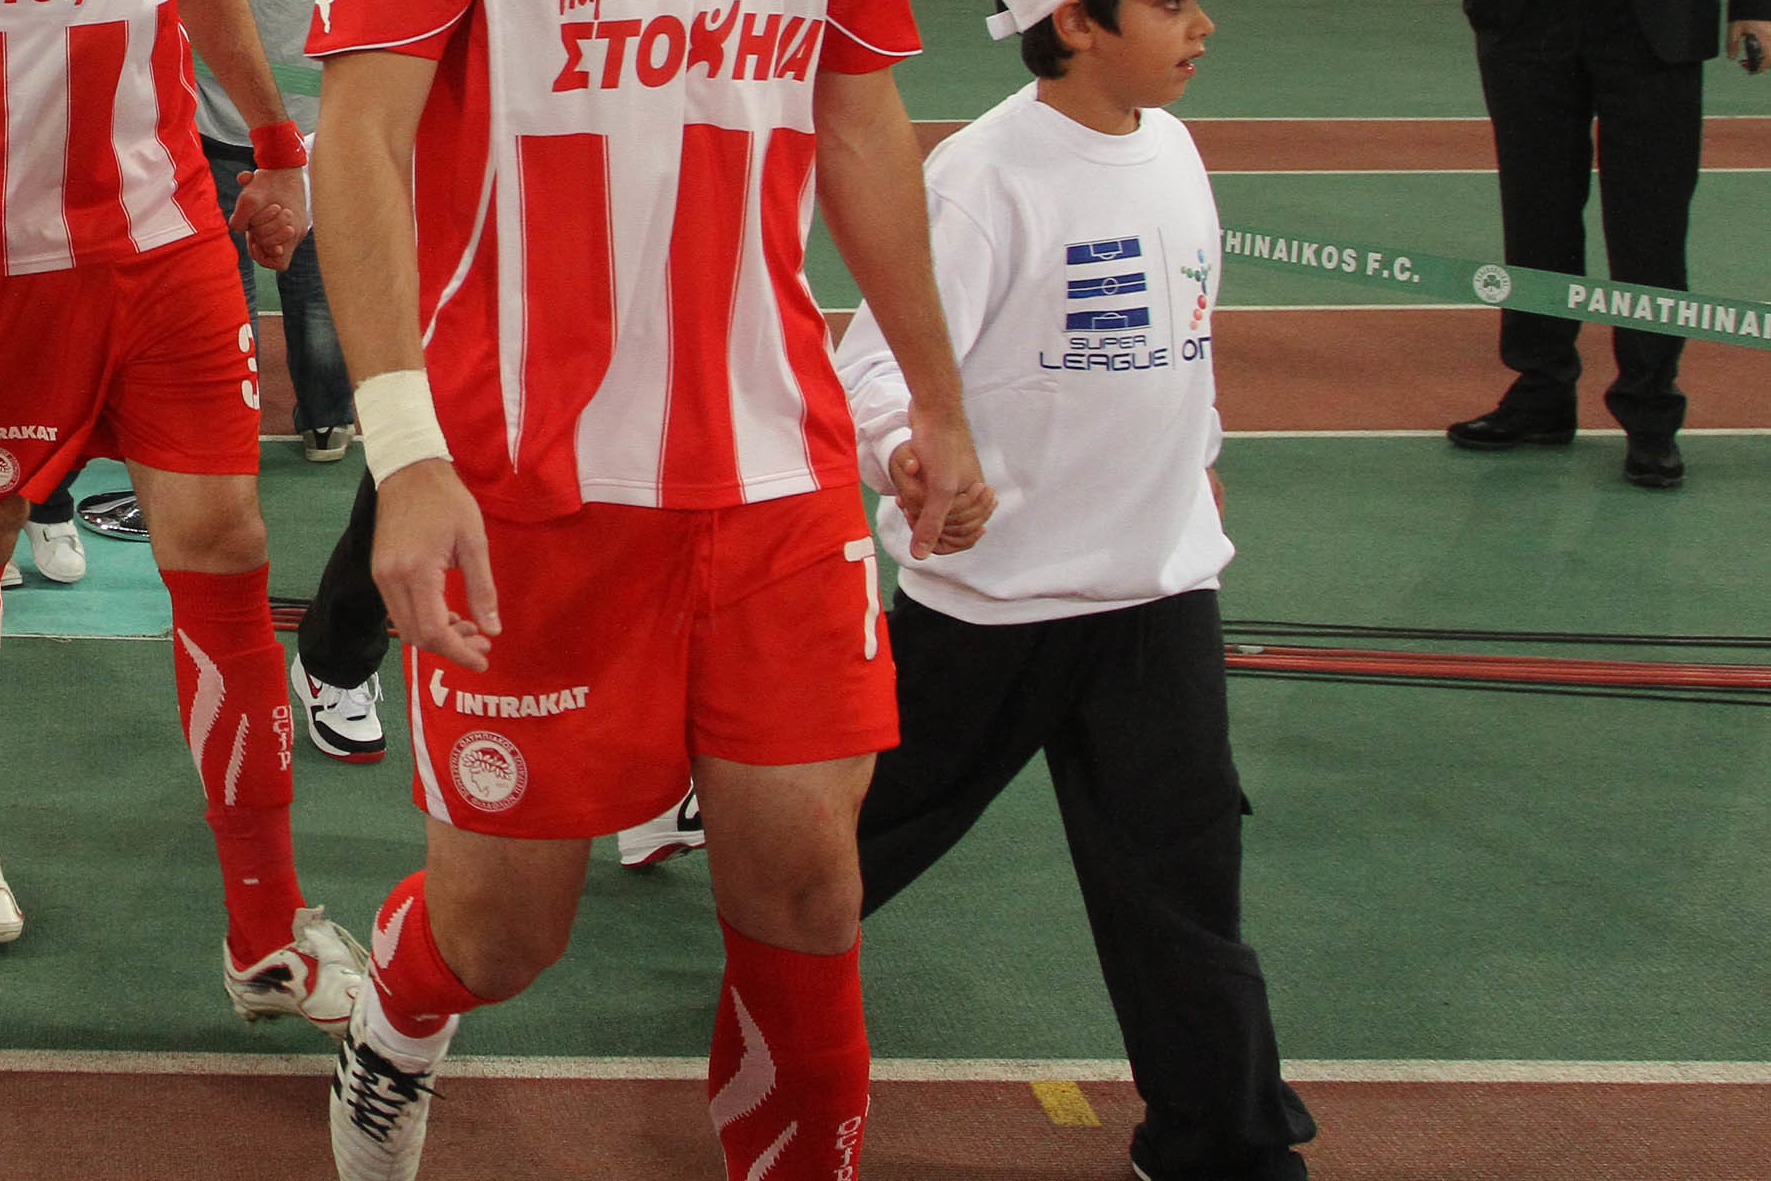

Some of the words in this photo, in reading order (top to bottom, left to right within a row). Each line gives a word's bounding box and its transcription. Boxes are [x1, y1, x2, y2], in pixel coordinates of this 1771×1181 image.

[1219, 229, 1358, 273] HINAIKOS
[1365, 251, 1421, 283] F.C.
[1069, 334, 1147, 350] SUPER
[1039, 348, 1169, 371] LEAGUE
[455, 685, 590, 719] INTRAKAT
